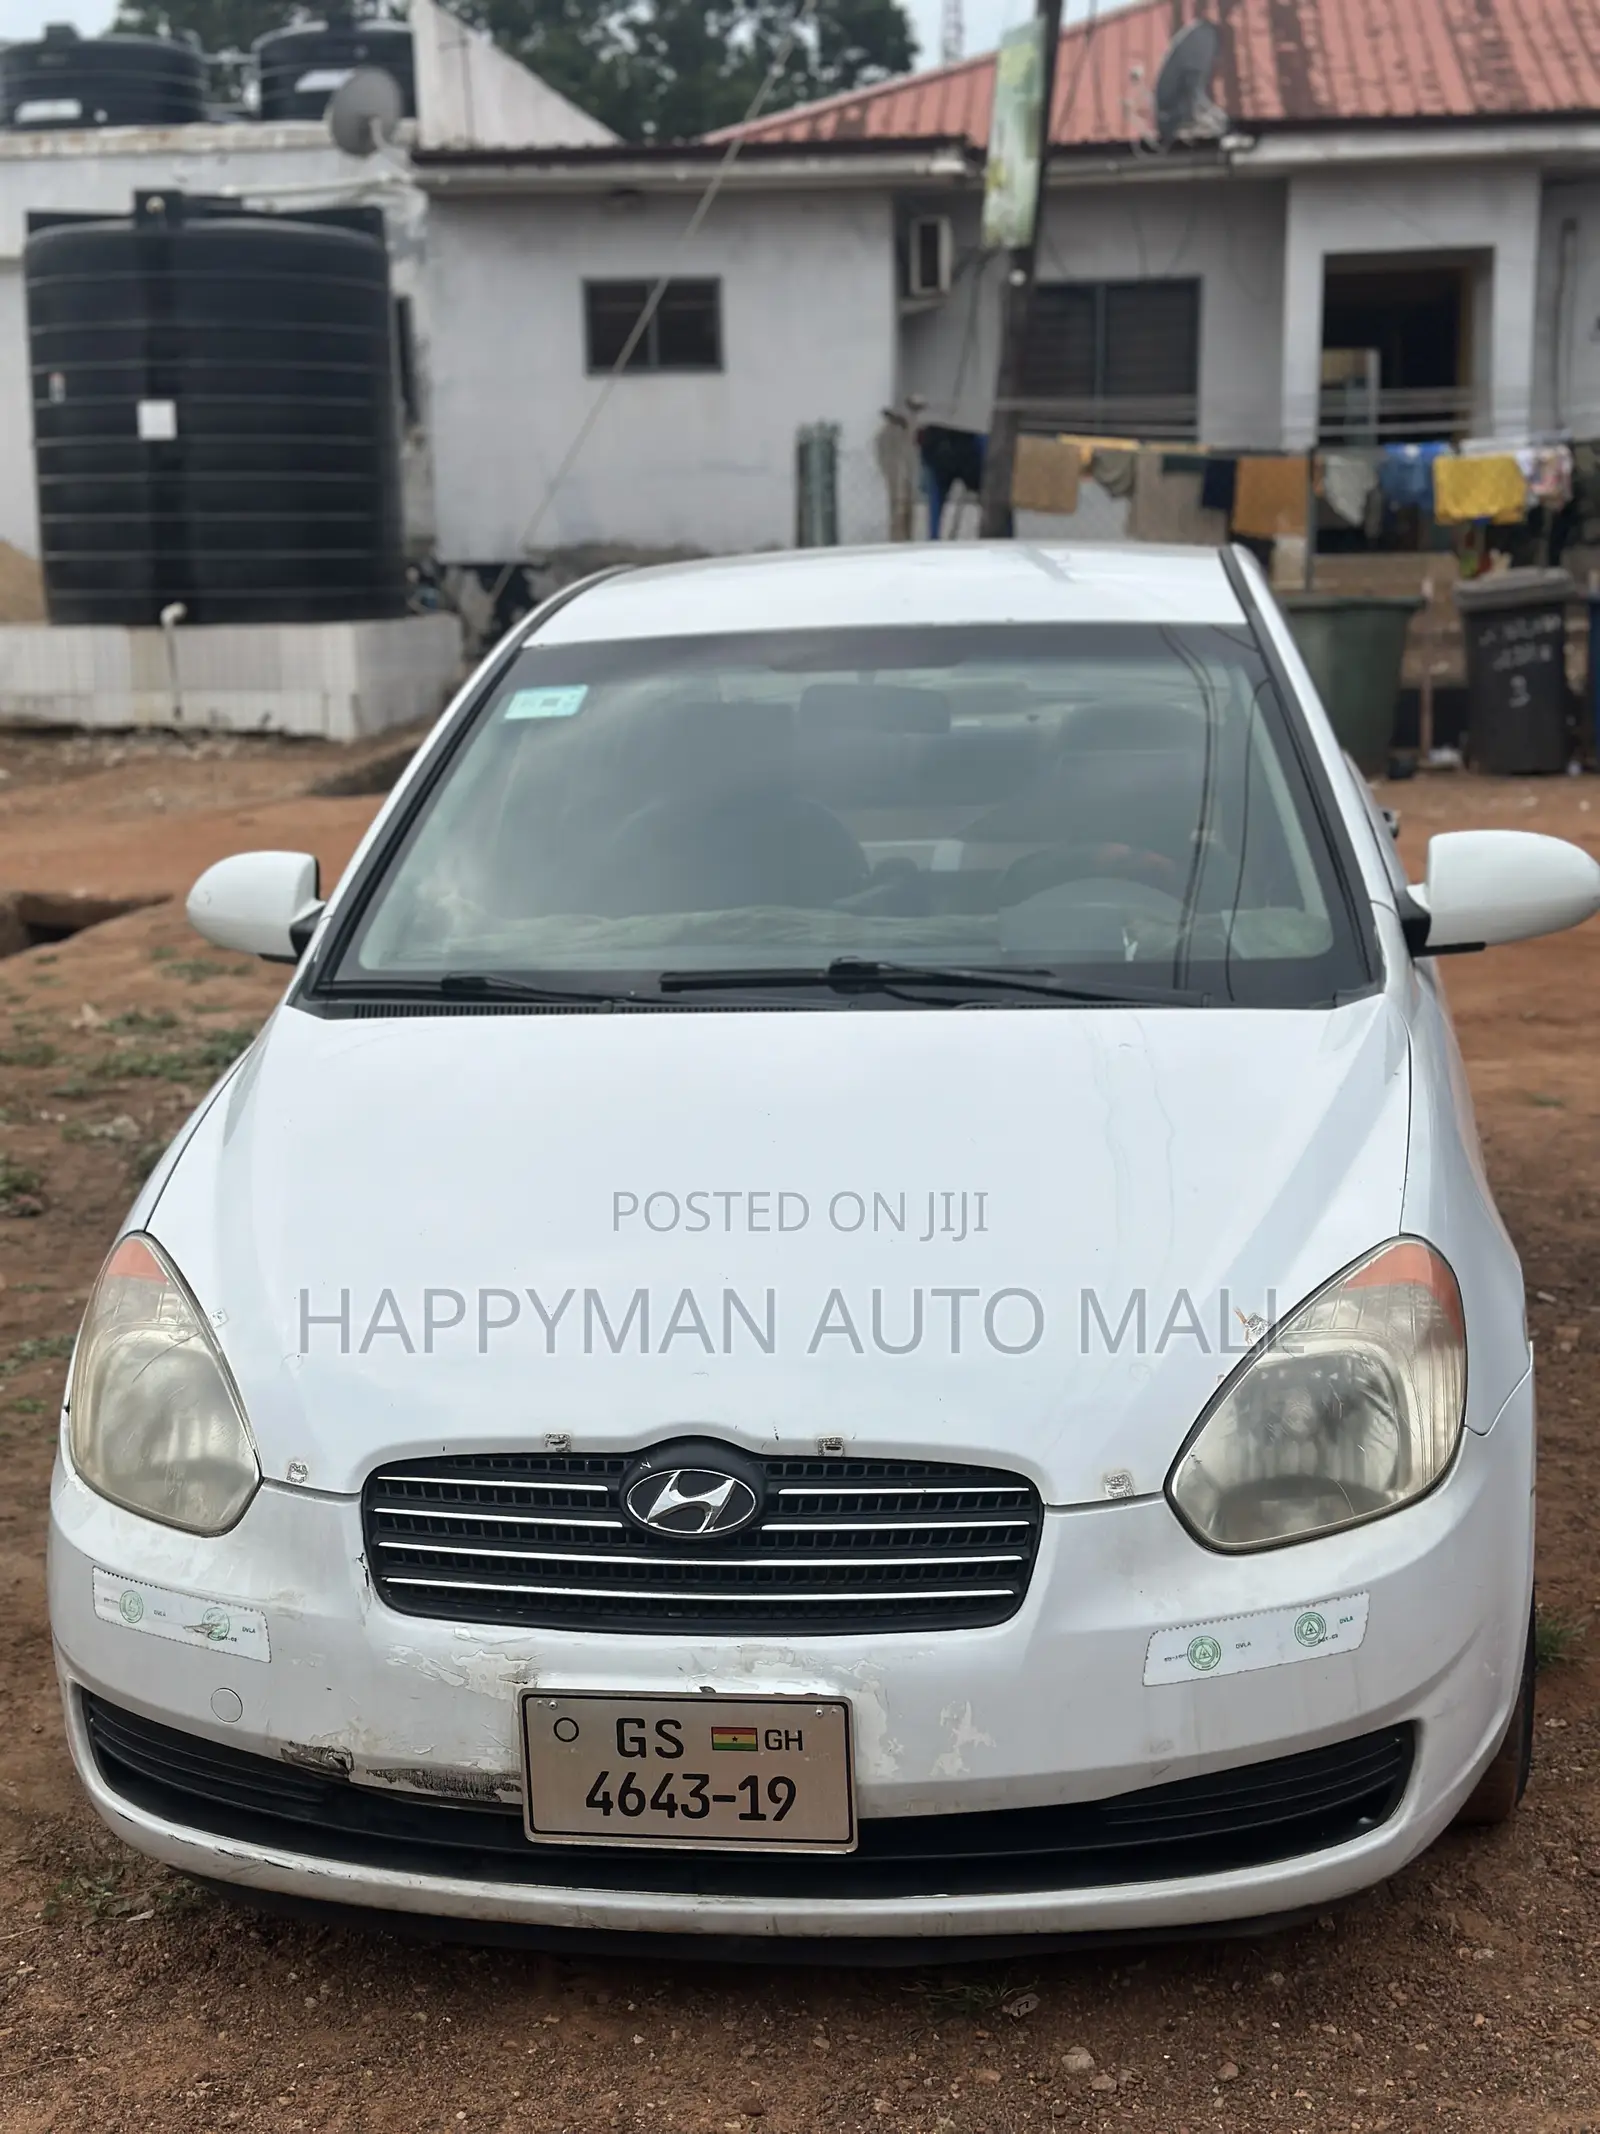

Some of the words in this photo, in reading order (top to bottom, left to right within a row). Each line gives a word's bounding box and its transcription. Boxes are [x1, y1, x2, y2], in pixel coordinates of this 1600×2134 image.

[616, 1718, 685, 1759] GS
[764, 1729, 804, 1751] GH
[586, 1770, 797, 1822] 4643-19
